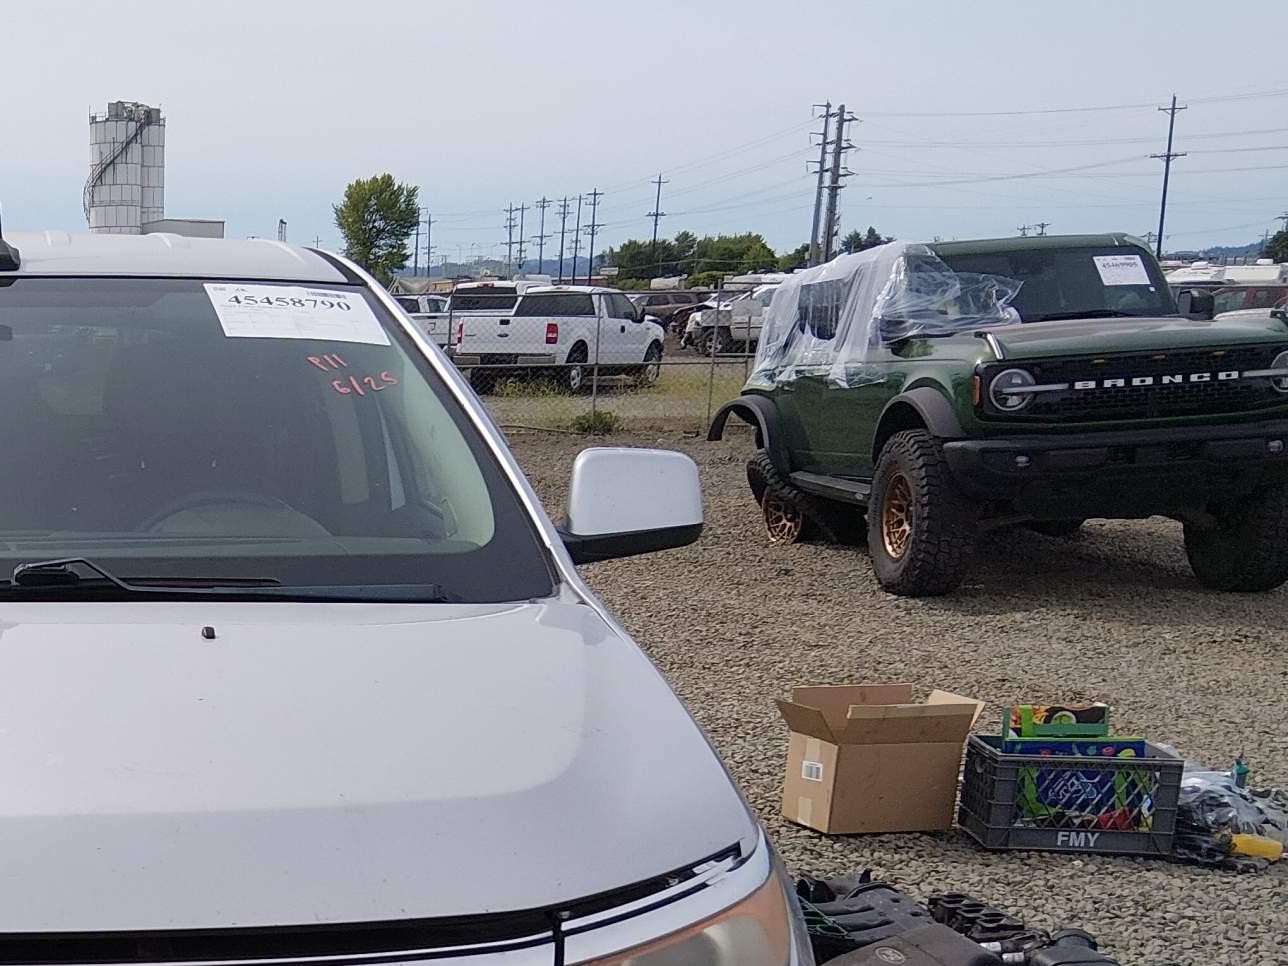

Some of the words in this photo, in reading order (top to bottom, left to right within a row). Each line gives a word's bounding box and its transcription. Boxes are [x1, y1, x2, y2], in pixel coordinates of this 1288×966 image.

[228, 295, 352, 312] 45458790
[332, 371, 399, 396] 6/25
[1074, 371, 1240, 390] BRONCO
[1056, 831, 1100, 848] FMY
